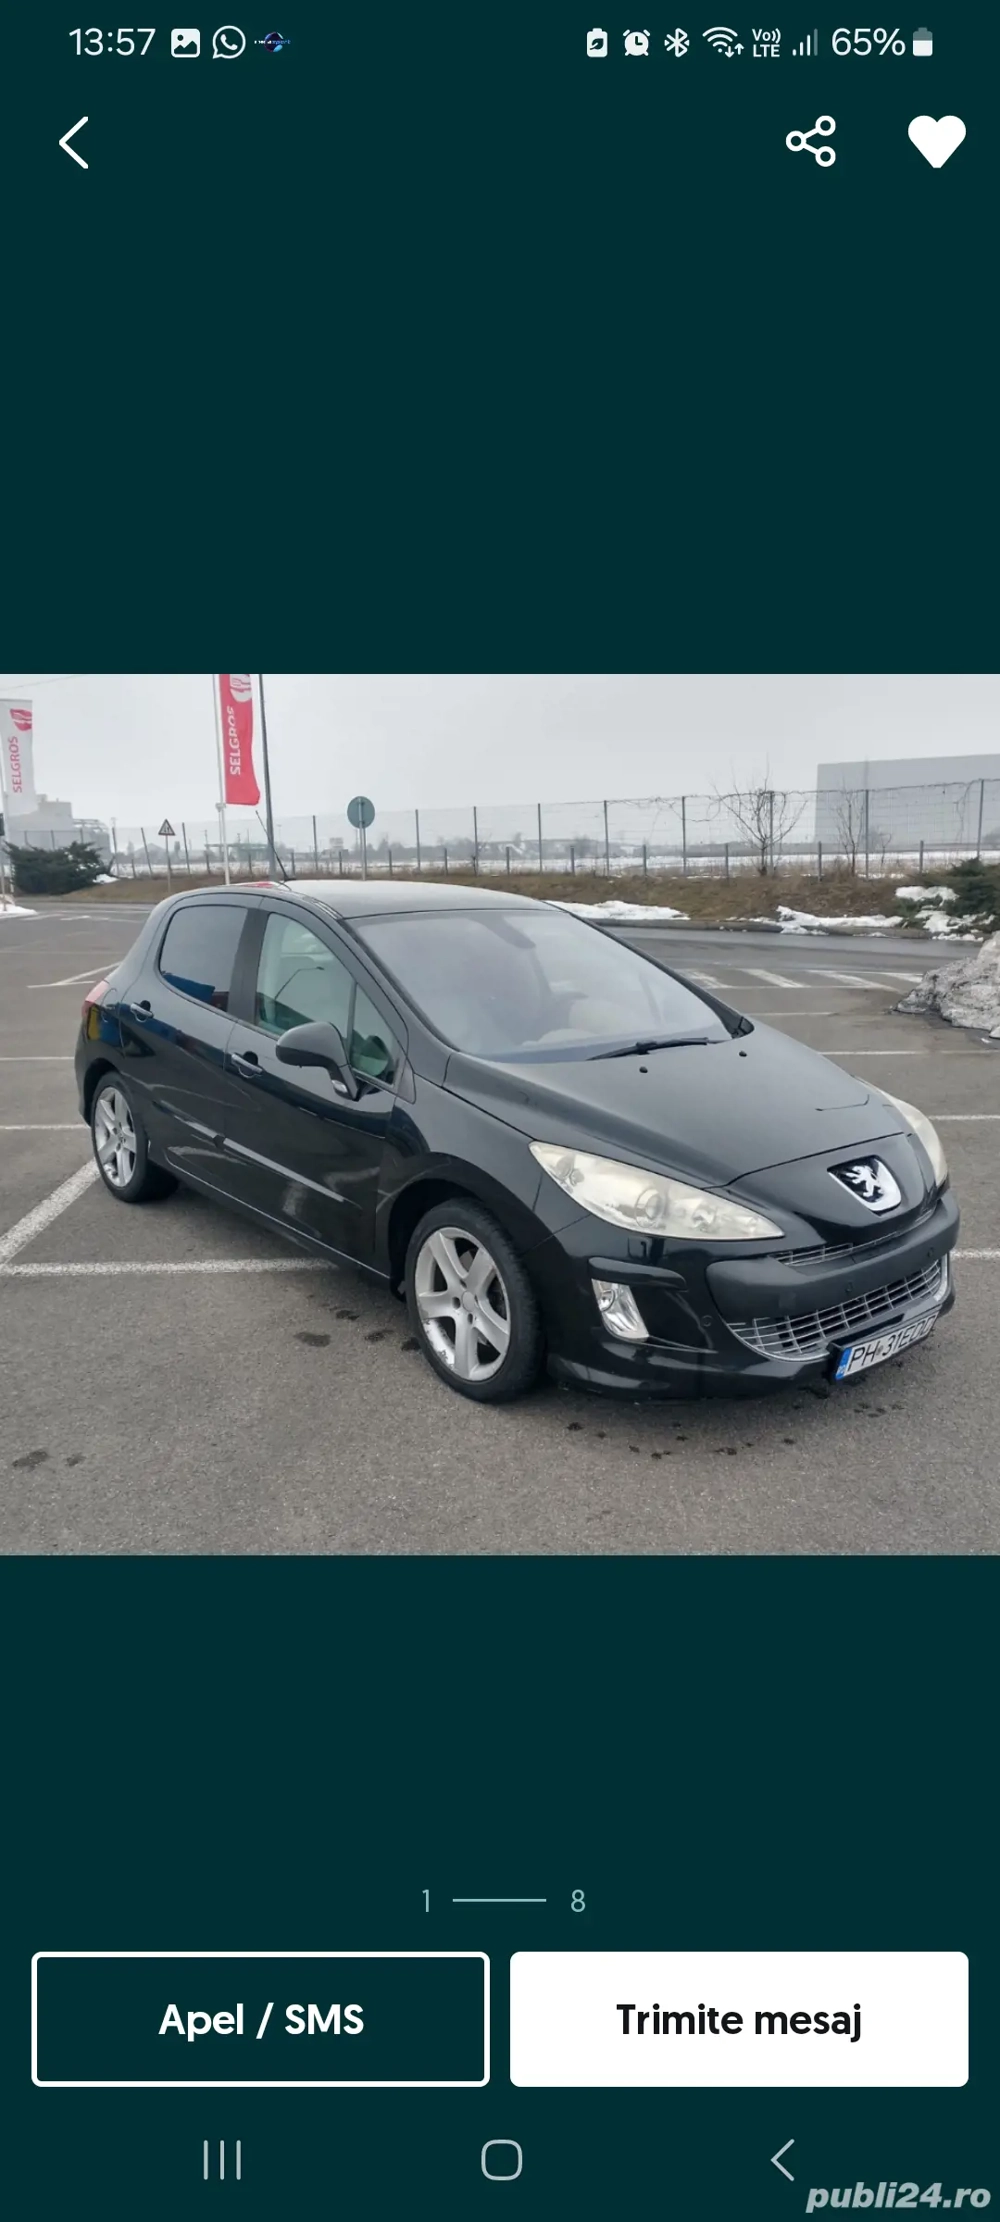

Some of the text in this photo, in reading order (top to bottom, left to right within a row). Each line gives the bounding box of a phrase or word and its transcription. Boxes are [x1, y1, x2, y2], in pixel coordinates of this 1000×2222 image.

[69, 28, 155, 55] 13:57
[753, 44, 780, 57] LTE
[832, 28, 905, 56] 65%
[227, 705, 241, 775] SELGROS
[8, 736, 22, 793] SELGROS
[422, 1889, 586, 1913] 1 8
[158, 2003, 244, 2042] Apel
[284, 2003, 365, 2035] SMS
[616, 2003, 861, 2043] Trimite mesaj
